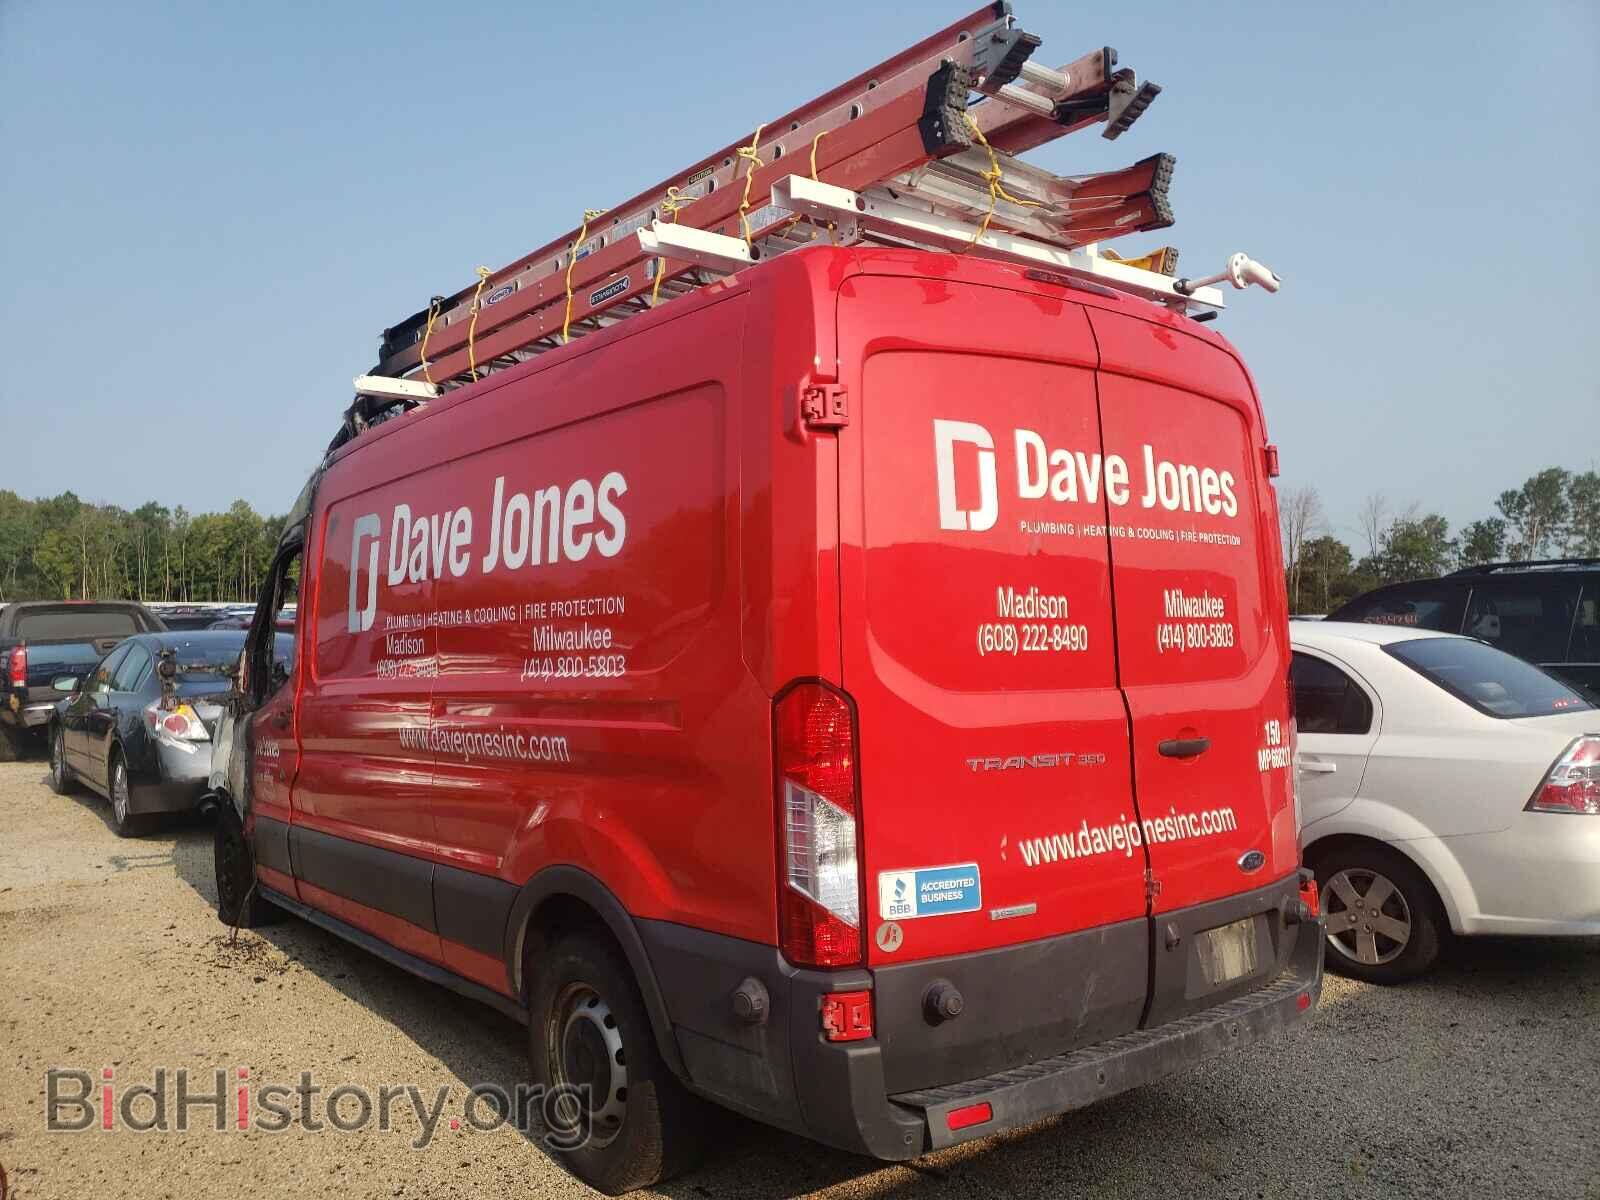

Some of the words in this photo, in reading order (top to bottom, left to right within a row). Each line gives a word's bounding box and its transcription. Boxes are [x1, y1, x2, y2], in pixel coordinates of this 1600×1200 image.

[1014, 427, 1131, 506] Dave
[1141, 444, 1238, 517] Jones
[388, 503, 472, 586] Dave
[482, 472, 628, 574] Jones
[1020, 520, 1075, 536] PLUMBING
[1083, 524, 1126, 538] HEATING
[1128, 527, 1135, 537] &
[1137, 528, 1174, 541] COOLING
[1181, 530, 1198, 543] FIRE
[1199, 532, 1241, 546] PROTECTION
[386, 612, 422, 630] PLUMBING
[427, 609, 463, 627] HEATING
[473, 606, 516, 625] COOLING
[525, 602, 547, 620] FIRE
[550, 596, 625, 618] PROTECTION
[997, 586, 1069, 619] Madison
[1163, 589, 1225, 619] Milwaukee
[386, 633, 425, 655] Madison
[533, 622, 612, 652] Milwaukee
[978, 624, 1019, 656] (608)
[1022, 624, 1088, 652] 222-8490
[1157, 624, 1186, 653] (414)
[1187, 623, 1234, 648] 800-5803
[554, 655, 626, 678] 800-5803
[399, 723, 571, 763] www.davejonesinc.com
[1264, 719, 1281, 746] 150
[966, 752, 1076, 772] TRANSIT
[1018, 805, 1238, 868] www.davejonesinc.com
[921, 877, 975, 892] ACCREDITED
[921, 890, 964, 903] BUSINESS
[889, 904, 912, 915] BBB
